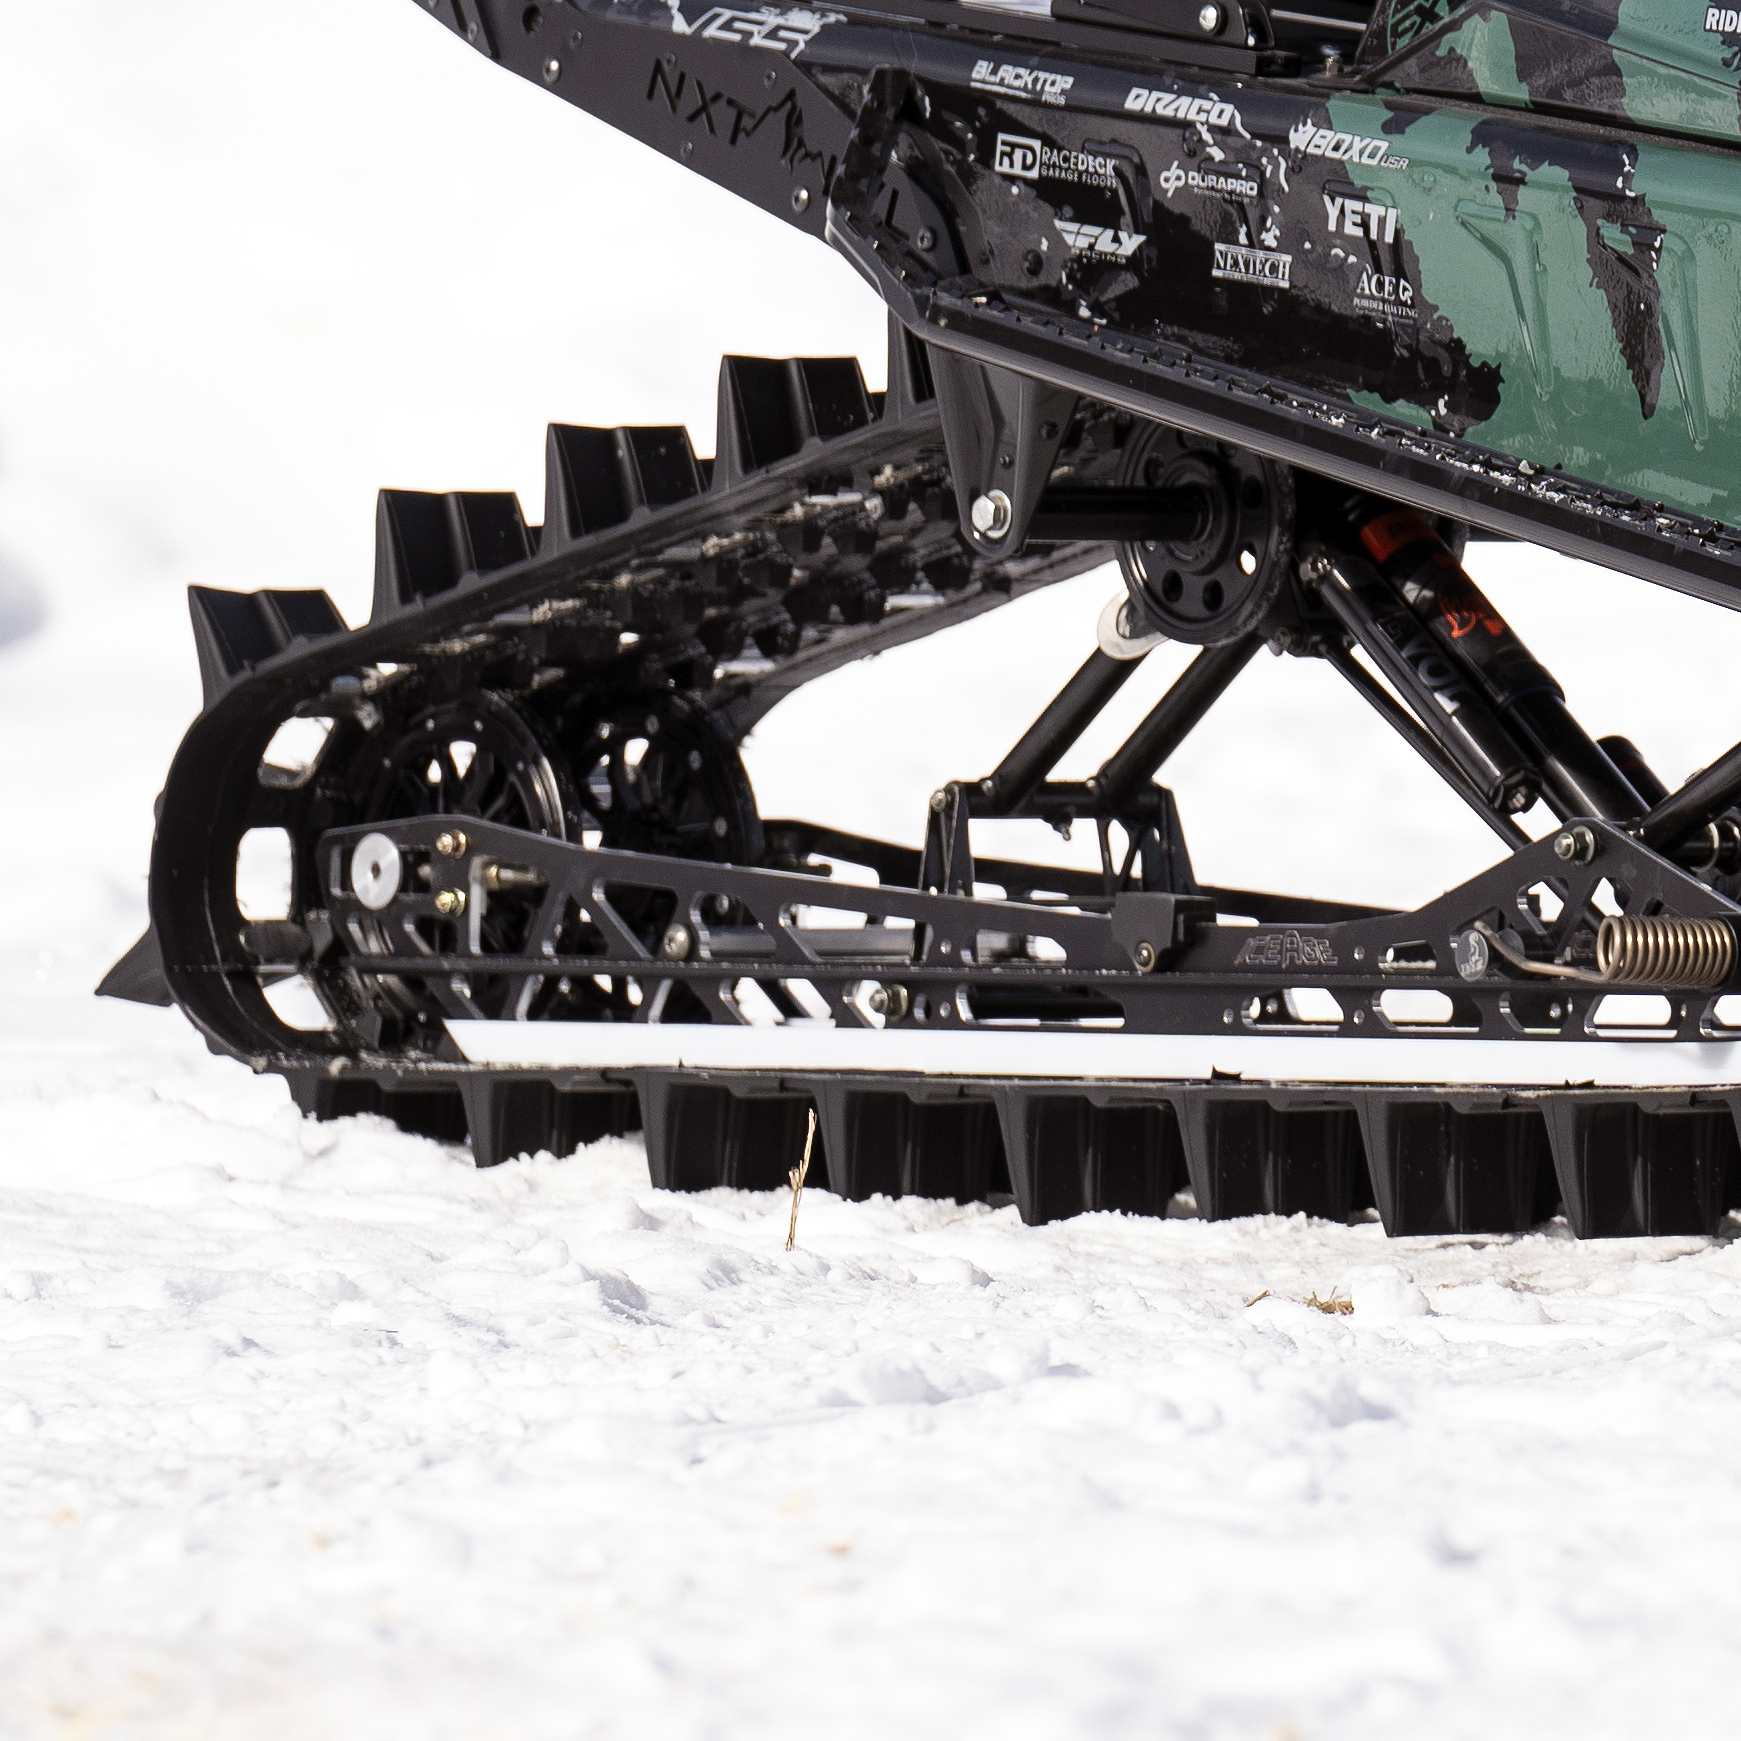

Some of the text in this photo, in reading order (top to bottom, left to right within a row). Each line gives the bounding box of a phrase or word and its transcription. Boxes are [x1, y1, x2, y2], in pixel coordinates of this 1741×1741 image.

[971, 59, 1075, 93] BLACKTOP
[647, 57, 755, 147] NXT
[1123, 86, 1236, 127] DRACO
[1041, 146, 1115, 177] RACEDECK
[1304, 126, 1411, 171] BOXO USA
[1041, 168, 1118, 189] GARAGE FLOORS
[1187, 169, 1259, 197] DURAPRO
[1322, 192, 1399, 245] YETI
[1053, 219, 1148, 256] FLY
[1214, 248, 1291, 282] NEXTECH
[1356, 270, 1396, 301] ACE
